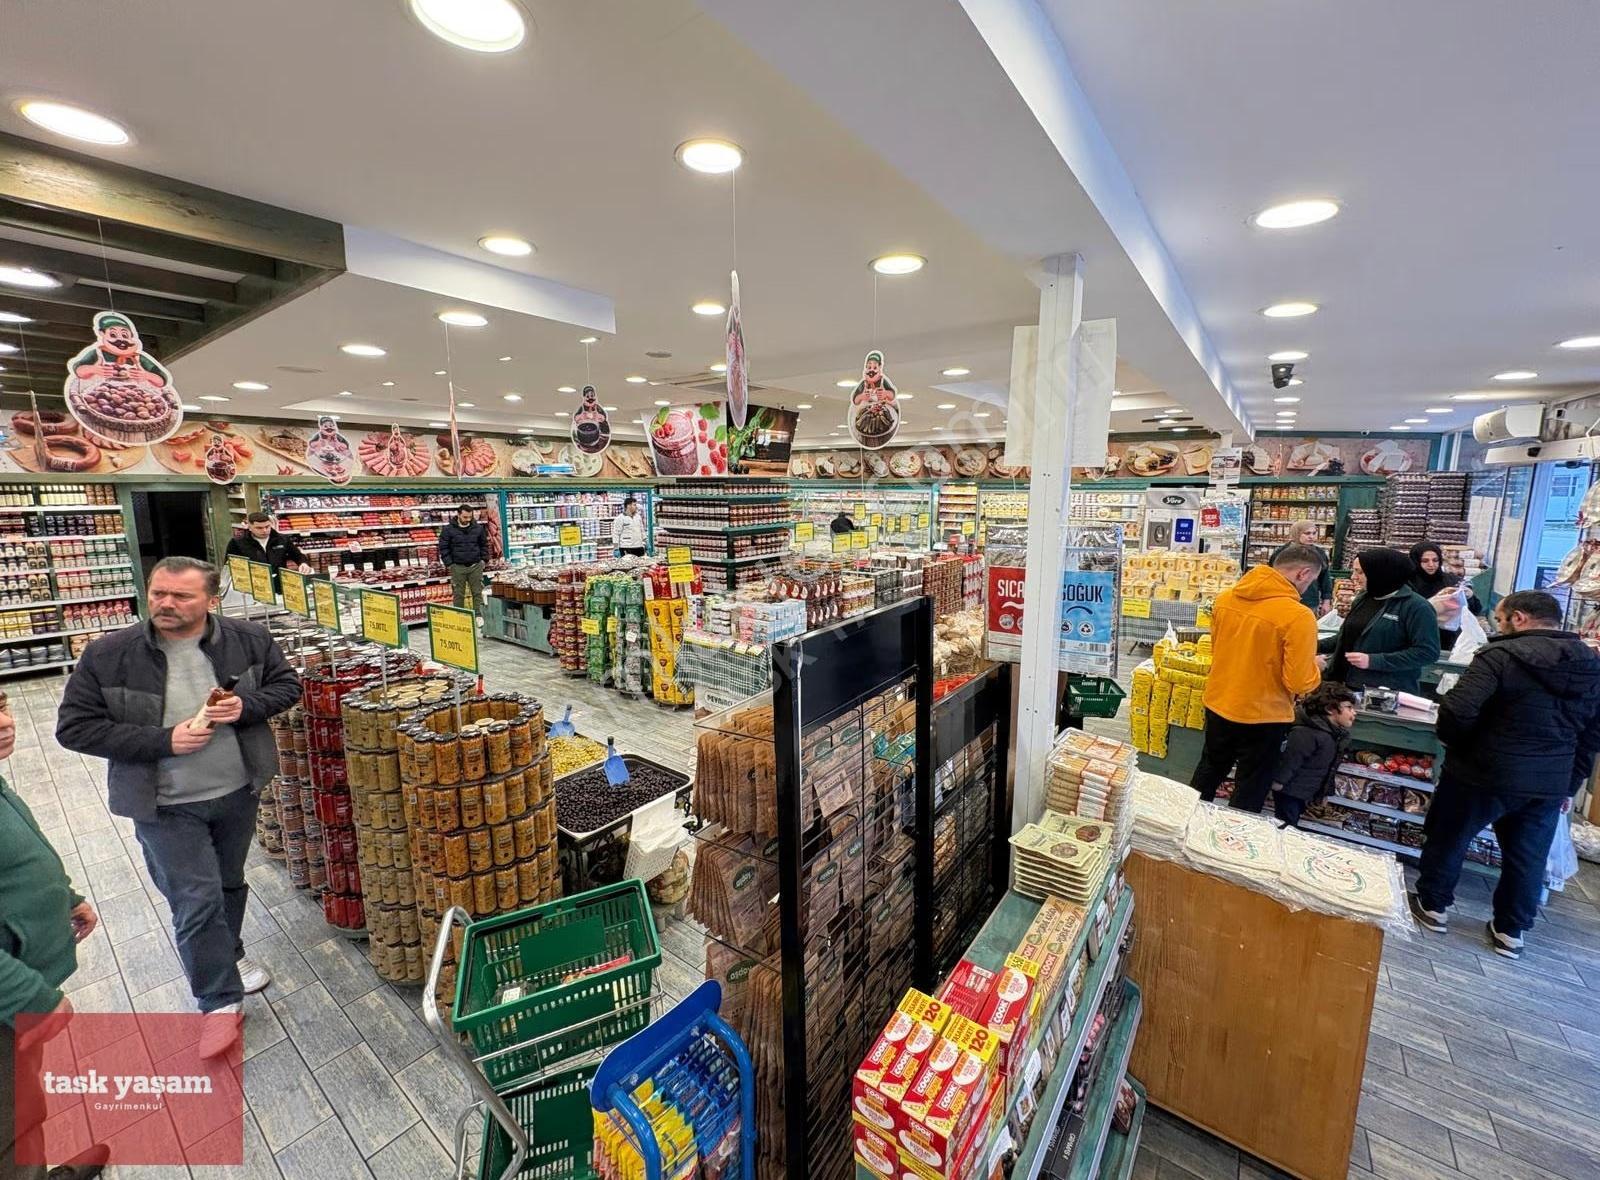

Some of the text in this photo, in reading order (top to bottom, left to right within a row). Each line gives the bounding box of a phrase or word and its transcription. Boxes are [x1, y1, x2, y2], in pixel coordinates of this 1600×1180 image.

[997, 579, 1025, 598] SICA
[1041, 955, 1057, 975] COOK
[921, 1001, 941, 1023] 120
[993, 999, 1010, 1024] COOK
[872, 1040, 889, 1062] COOK
[968, 1029, 989, 1052] 120
[894, 1051, 911, 1076] COOK
[916, 1068, 934, 1093] COOK
[940, 1082, 958, 1109] COOK
